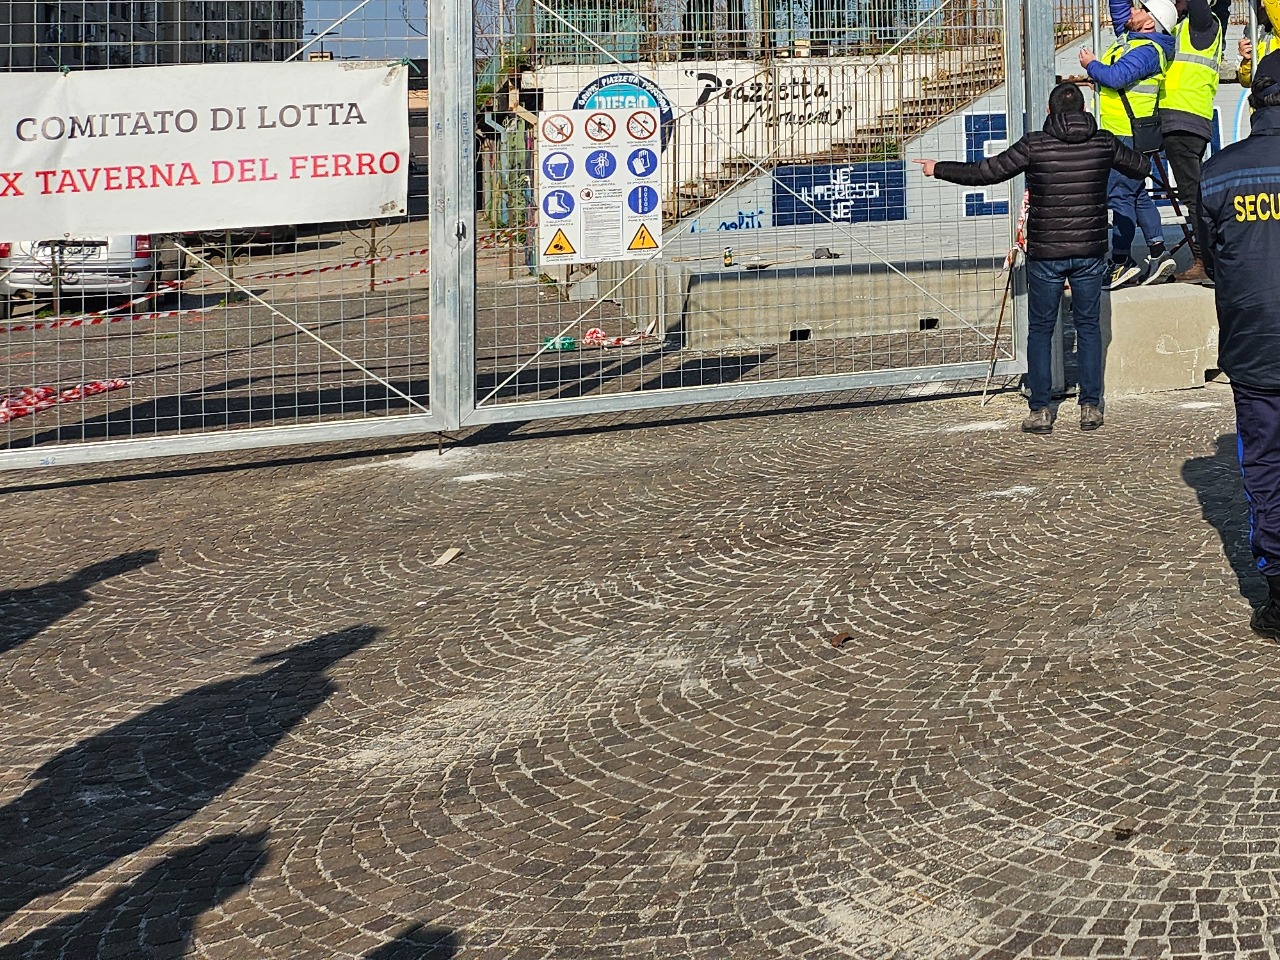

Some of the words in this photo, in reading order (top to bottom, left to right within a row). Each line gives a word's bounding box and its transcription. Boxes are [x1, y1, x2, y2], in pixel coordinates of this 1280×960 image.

[602, 75, 639, 86] PIAZZETTA
[16, 108, 198, 142] COMITATO
[210, 105, 246, 132] DI
[257, 102, 367, 130] LOTTA
[35, 162, 200, 196] TAVERNA
[211, 158, 278, 185] DEL
[289, 151, 401, 180] FERRO
